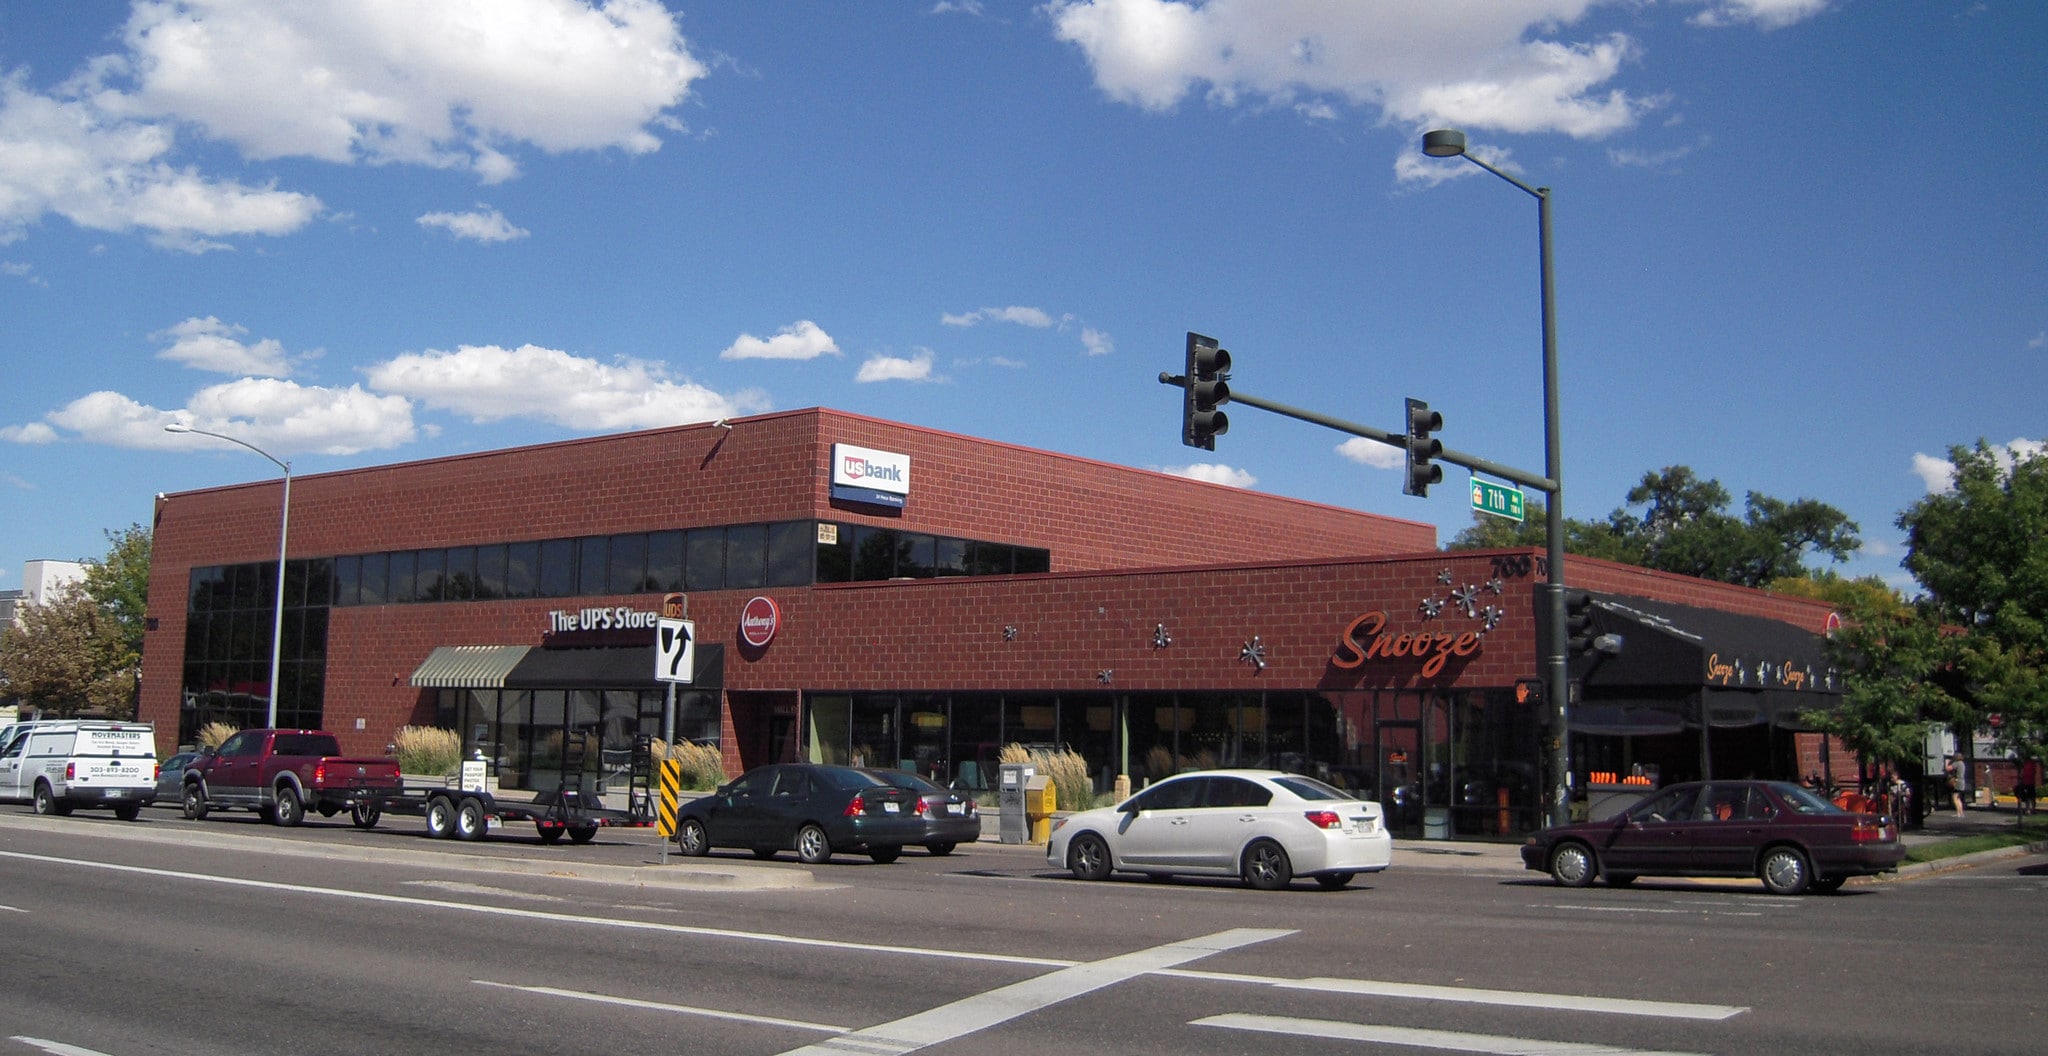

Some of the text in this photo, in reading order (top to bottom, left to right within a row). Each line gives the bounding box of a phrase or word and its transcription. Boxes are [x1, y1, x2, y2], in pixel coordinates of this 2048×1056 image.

[845, 459, 902, 482] usbank
[1487, 488, 1505, 510] 7th
[1490, 556, 1531, 577] 700
[549, 607, 658, 632] The UPS Store
[744, 612, 775, 631] Anthony's
[1332, 611, 1480, 678] Snooze
[1707, 653, 1734, 686] Snooze
[1782, 660, 1805, 691] Snooze
[91, 732, 141, 740] MOVEMASTERS
[90, 766, 140, 774] 303-893-8200
